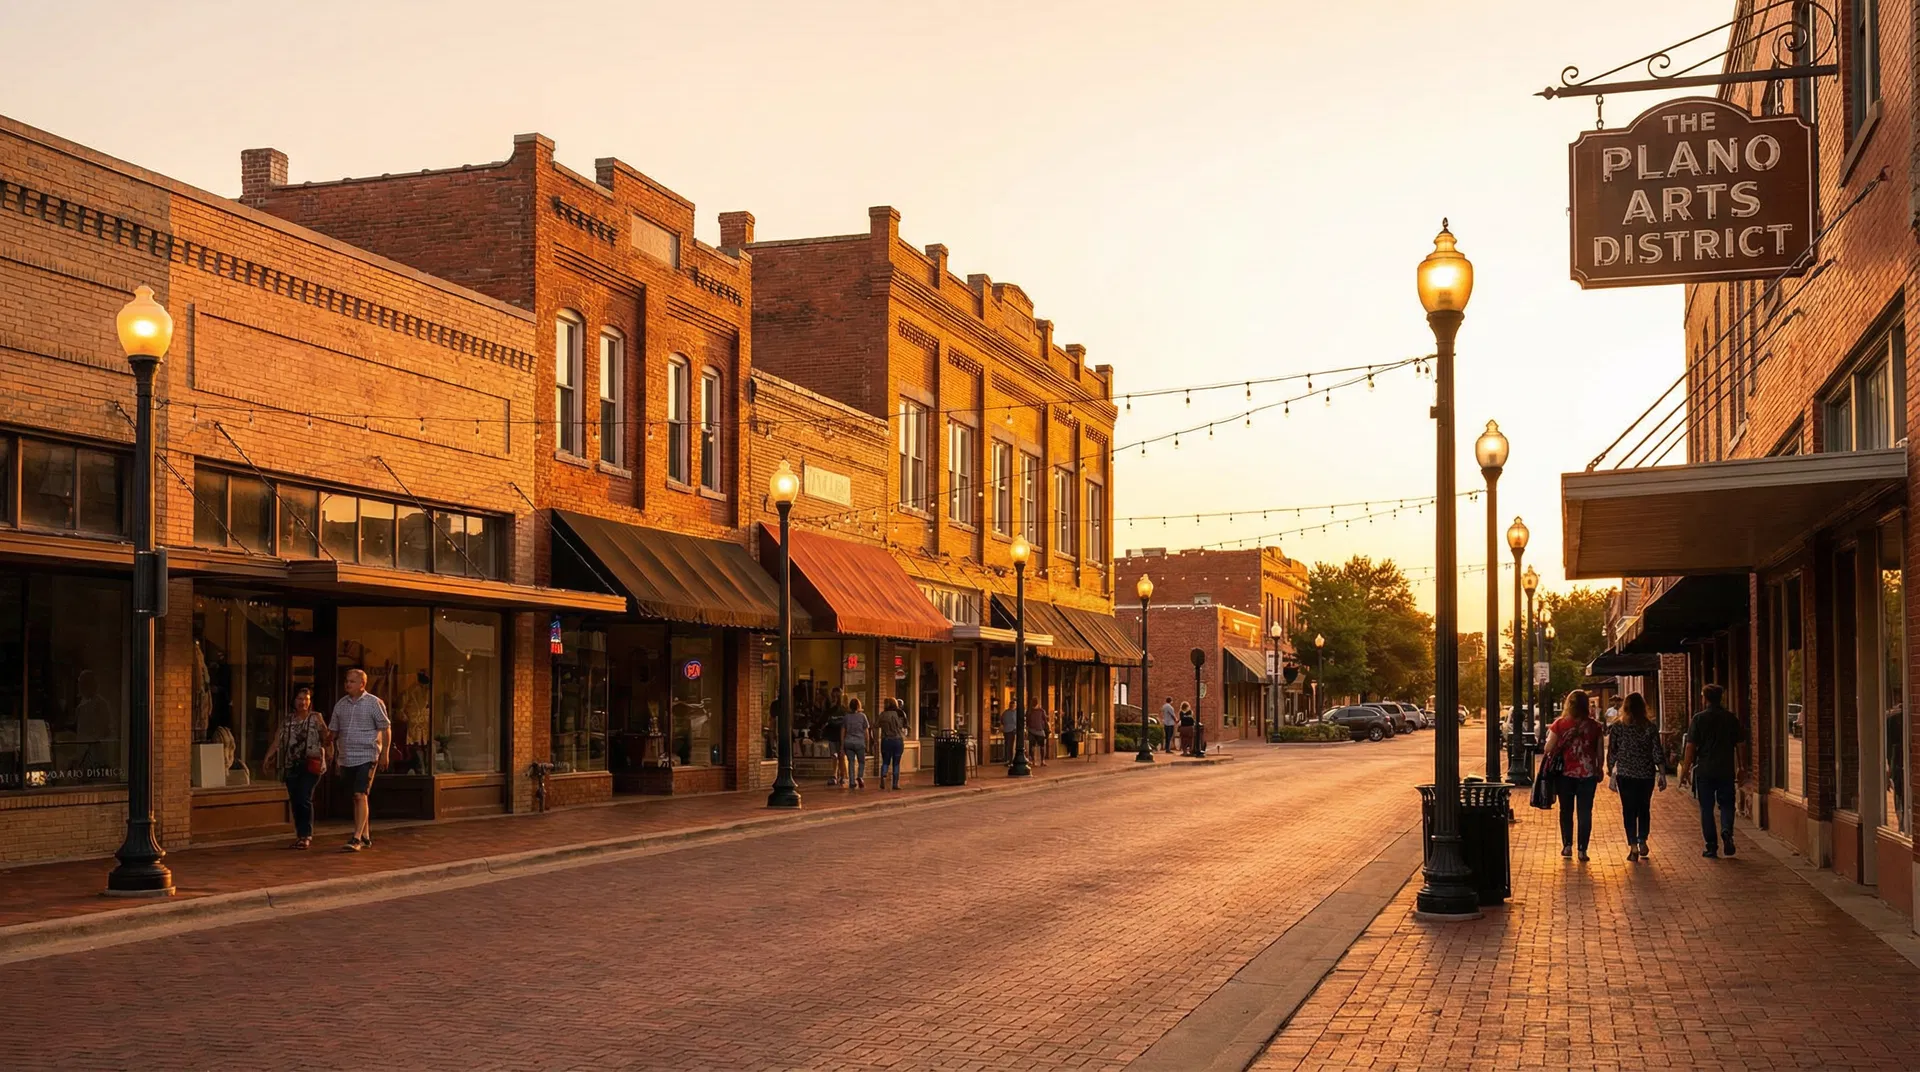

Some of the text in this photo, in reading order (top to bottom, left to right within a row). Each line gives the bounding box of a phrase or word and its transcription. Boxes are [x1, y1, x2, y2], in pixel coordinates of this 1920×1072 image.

[1662, 111, 1716, 134] THE
[1602, 134, 1781, 182] PLANO
[1622, 181, 1761, 225] ARTS
[1593, 223, 1793, 267] DISTRICT
